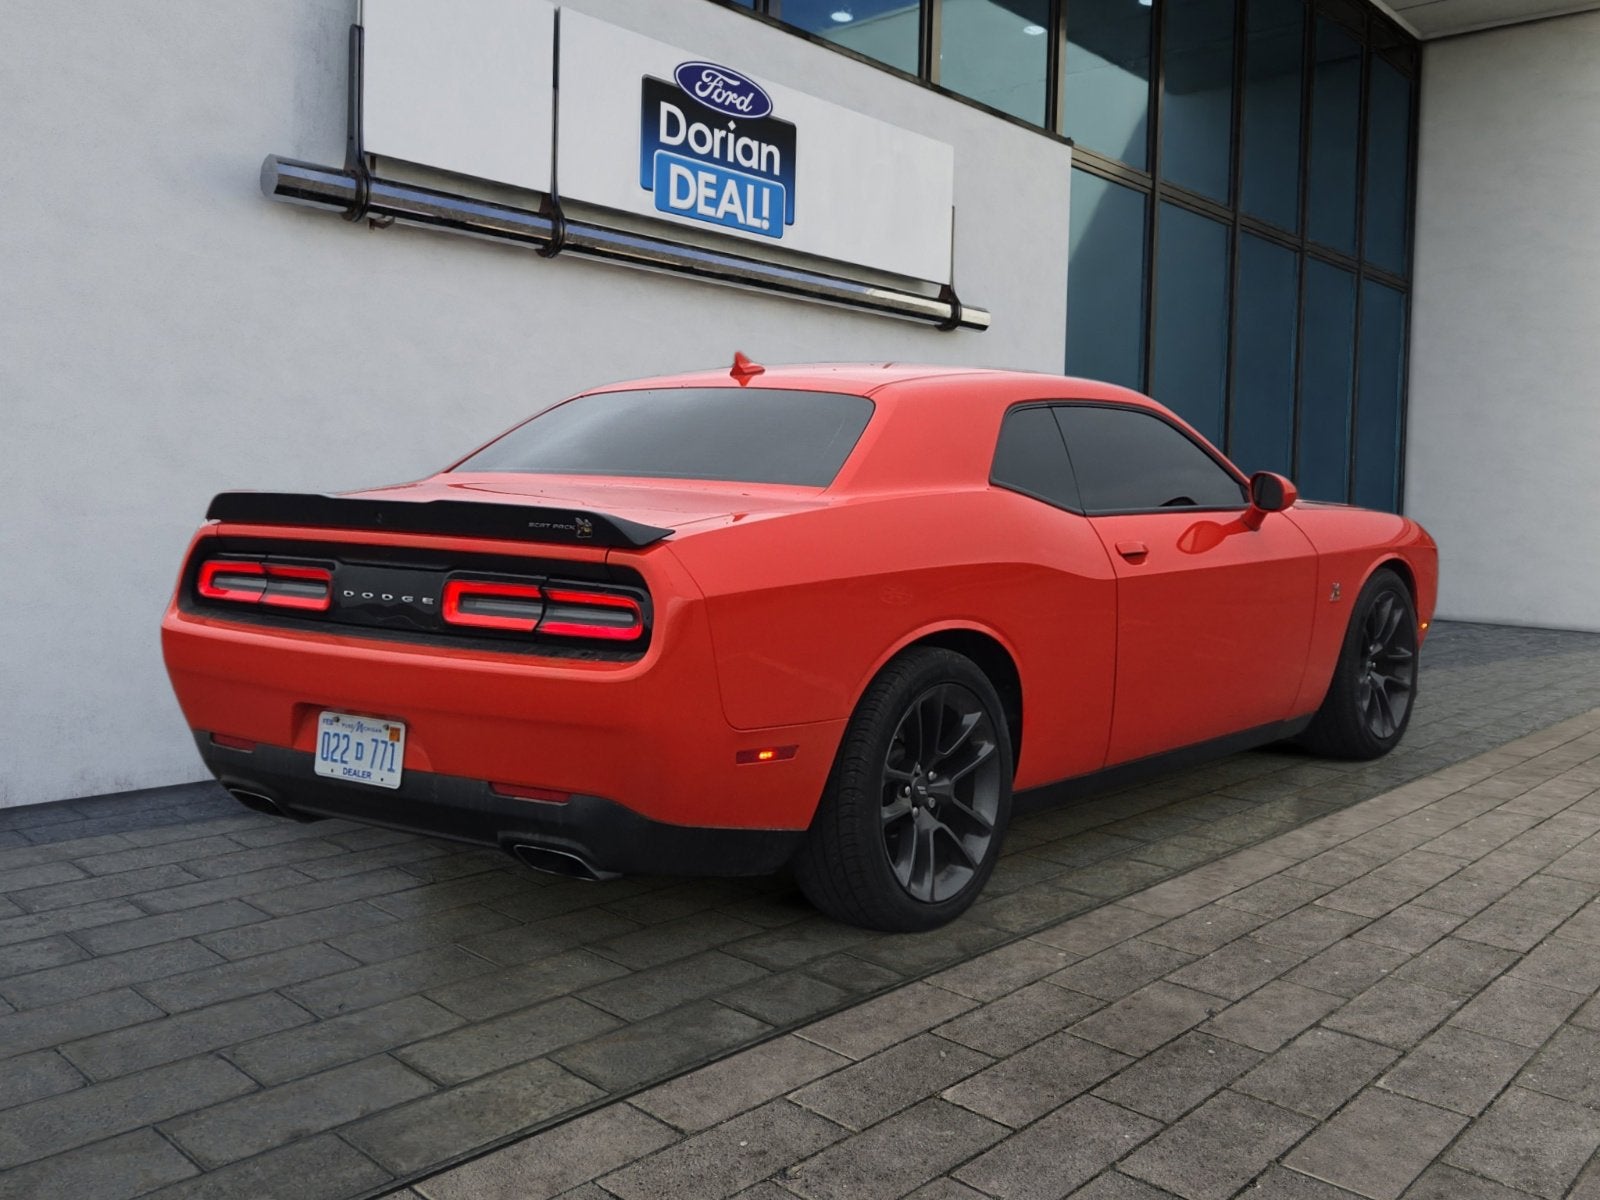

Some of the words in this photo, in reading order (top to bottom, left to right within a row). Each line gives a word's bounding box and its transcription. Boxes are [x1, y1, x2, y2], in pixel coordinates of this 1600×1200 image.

[695, 69, 755, 112] Ford
[659, 100, 781, 176] Dorian
[669, 163, 770, 231] DEAL!
[343, 585, 434, 605] DODGE
[321, 731, 350, 764] 022
[370, 738, 395, 773] 771
[343, 767, 372, 779] DEALER
